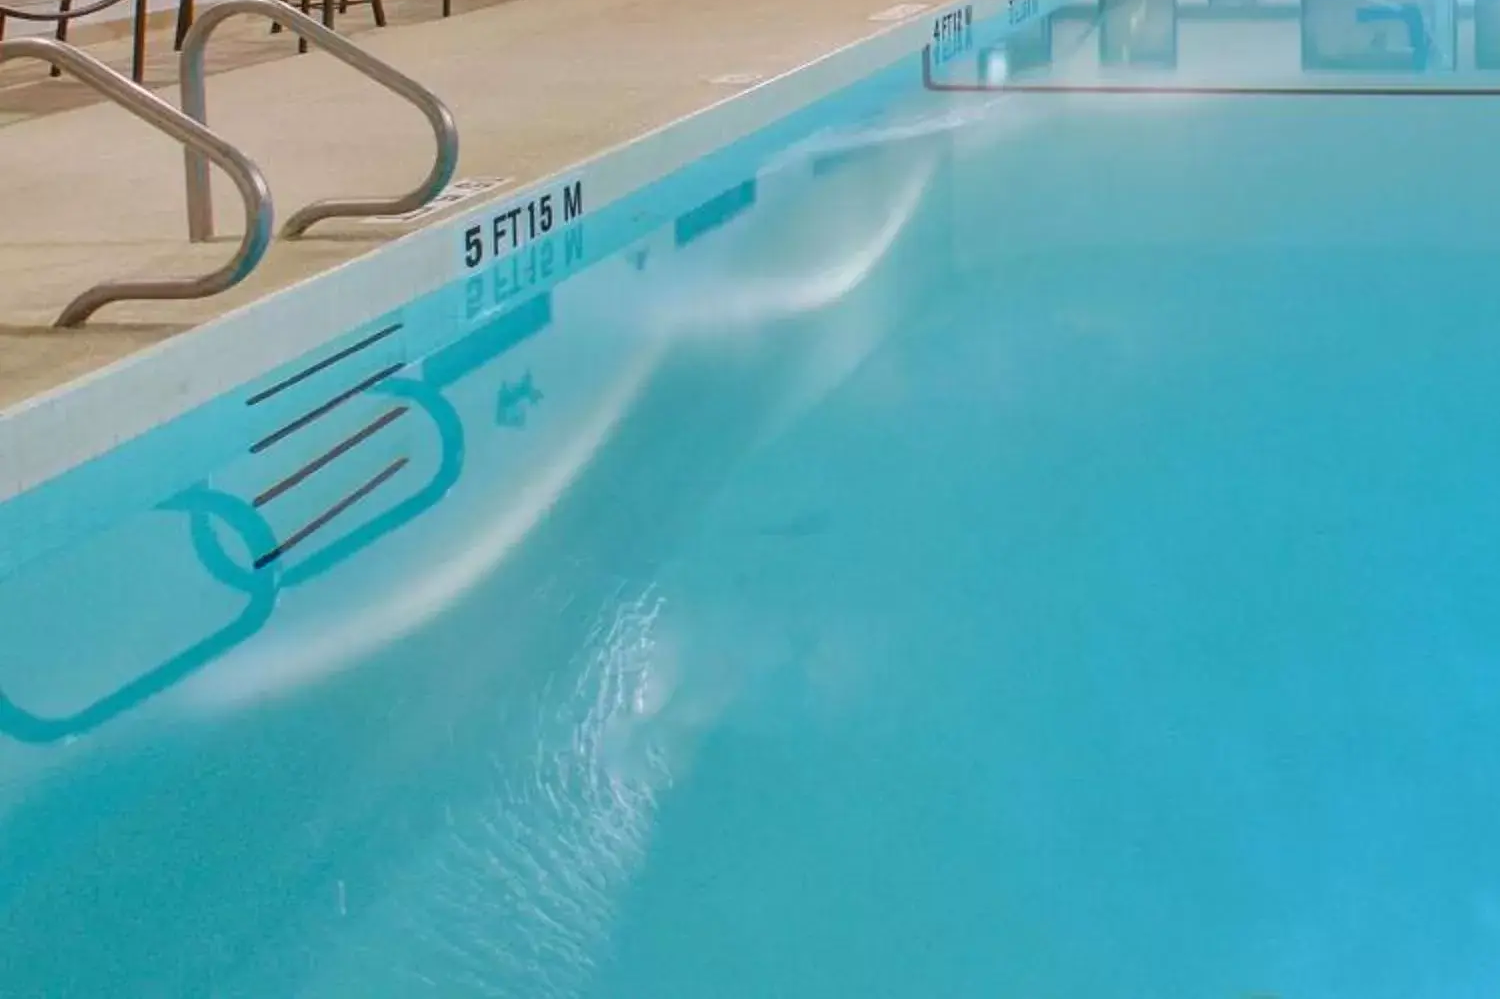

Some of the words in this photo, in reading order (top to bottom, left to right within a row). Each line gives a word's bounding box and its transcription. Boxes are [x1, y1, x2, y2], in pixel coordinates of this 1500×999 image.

[933, 19, 940, 41] 4
[465, 225, 482, 268] 5
[564, 180, 582, 221] M
